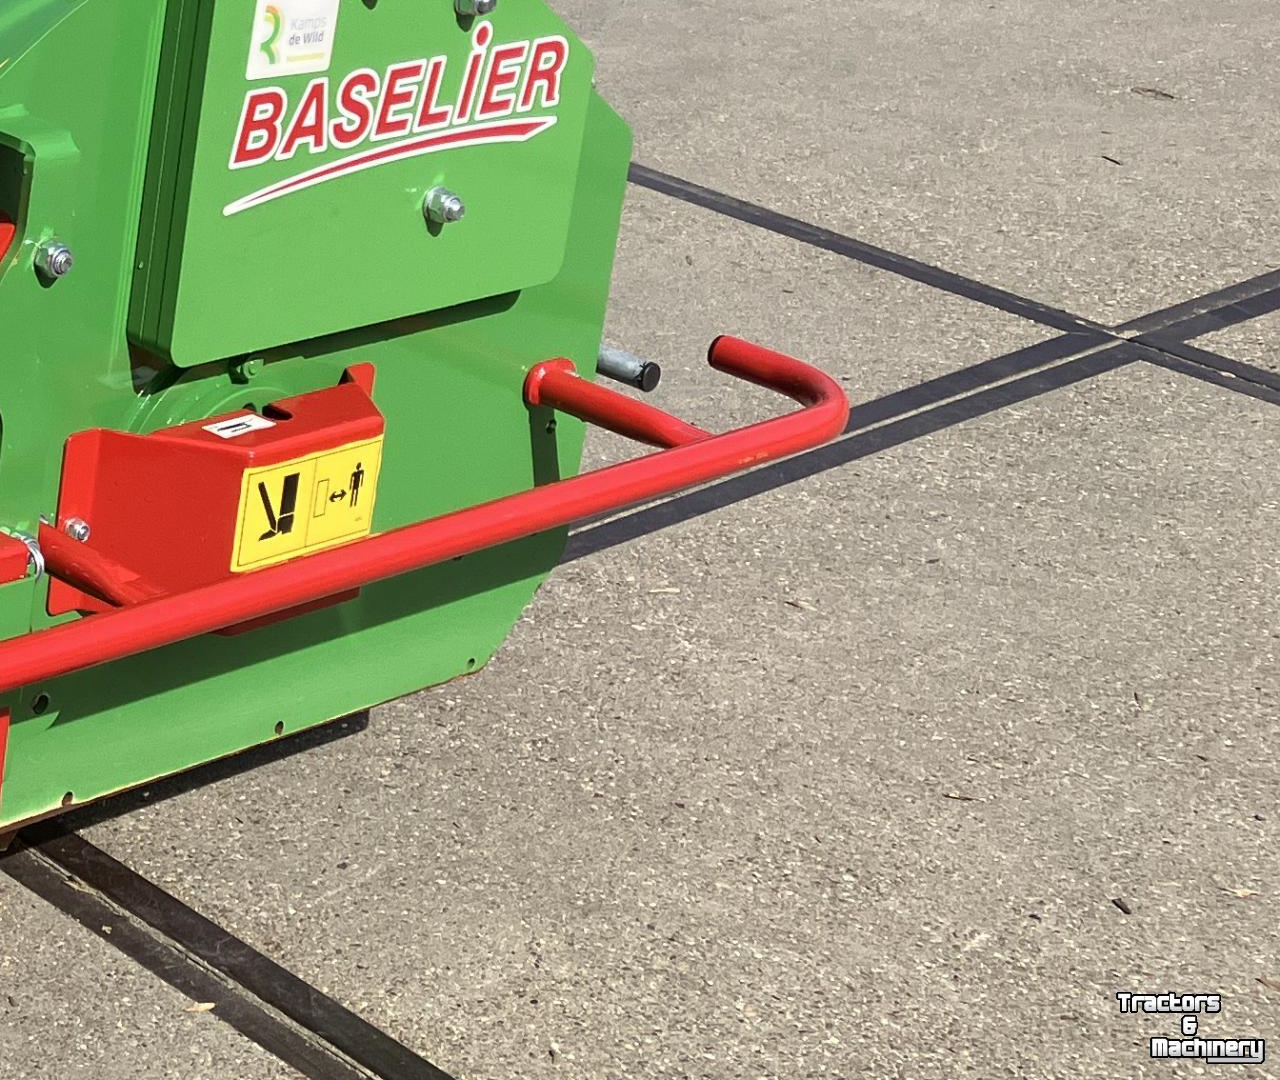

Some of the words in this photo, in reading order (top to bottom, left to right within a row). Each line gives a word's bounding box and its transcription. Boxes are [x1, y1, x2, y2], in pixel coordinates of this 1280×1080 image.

[290, 17, 328, 31] Kamps
[289, 34, 301, 46] de
[303, 32, 325, 44] Wild
[228, 21, 569, 170] BASELIER
